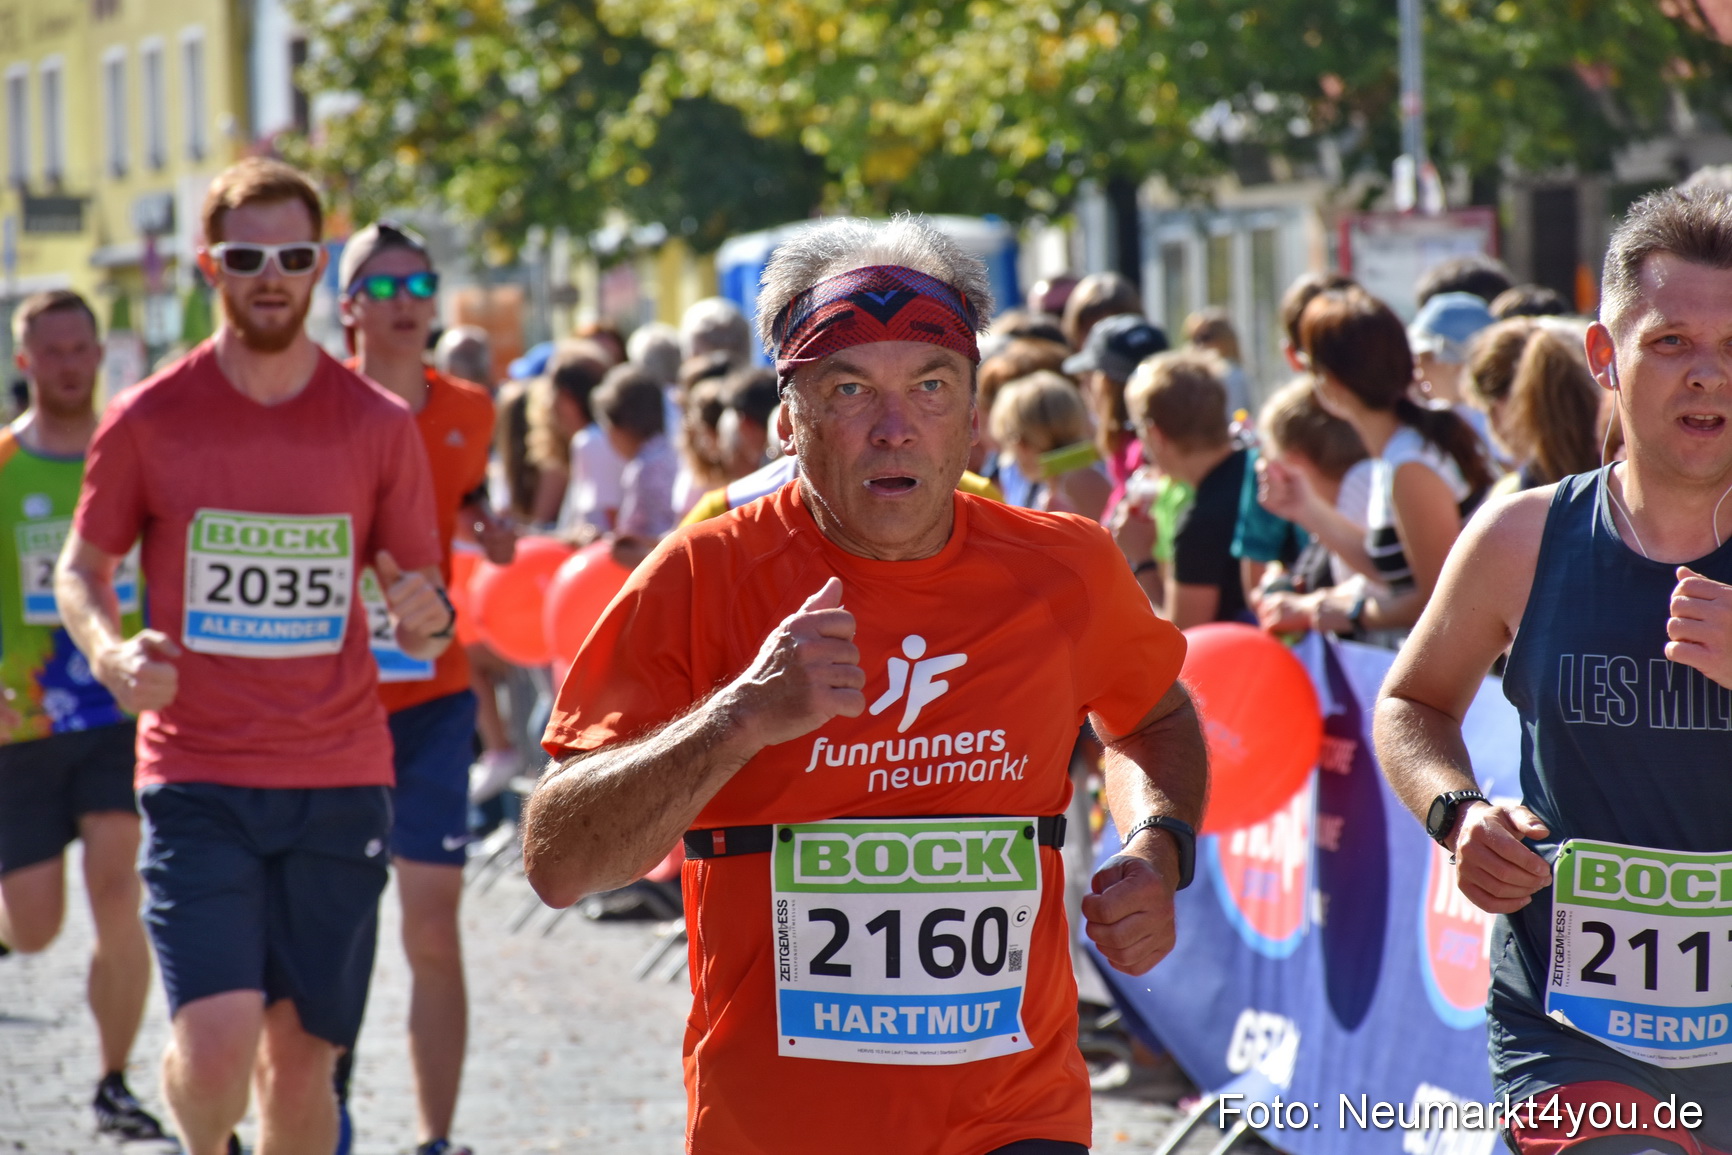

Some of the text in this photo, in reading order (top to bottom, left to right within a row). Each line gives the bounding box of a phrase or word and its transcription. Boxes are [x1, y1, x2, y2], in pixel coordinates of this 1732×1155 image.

[204, 519, 336, 552] BOCK
[206, 563, 332, 607] 2035
[200, 616, 330, 639] ALEXANDER
[1558, 653, 1732, 731] LES MIL
[805, 729, 1006, 773] funrunners
[867, 751, 1029, 793] neumarkt
[797, 833, 1017, 881] BOCK
[1576, 853, 1732, 906] BOC
[1016, 910, 1027, 923] C
[808, 906, 1009, 979] 2160
[1580, 920, 1732, 993] 211
[813, 1001, 1001, 1035] HARTMUT
[1607, 1009, 1729, 1043] BERND
